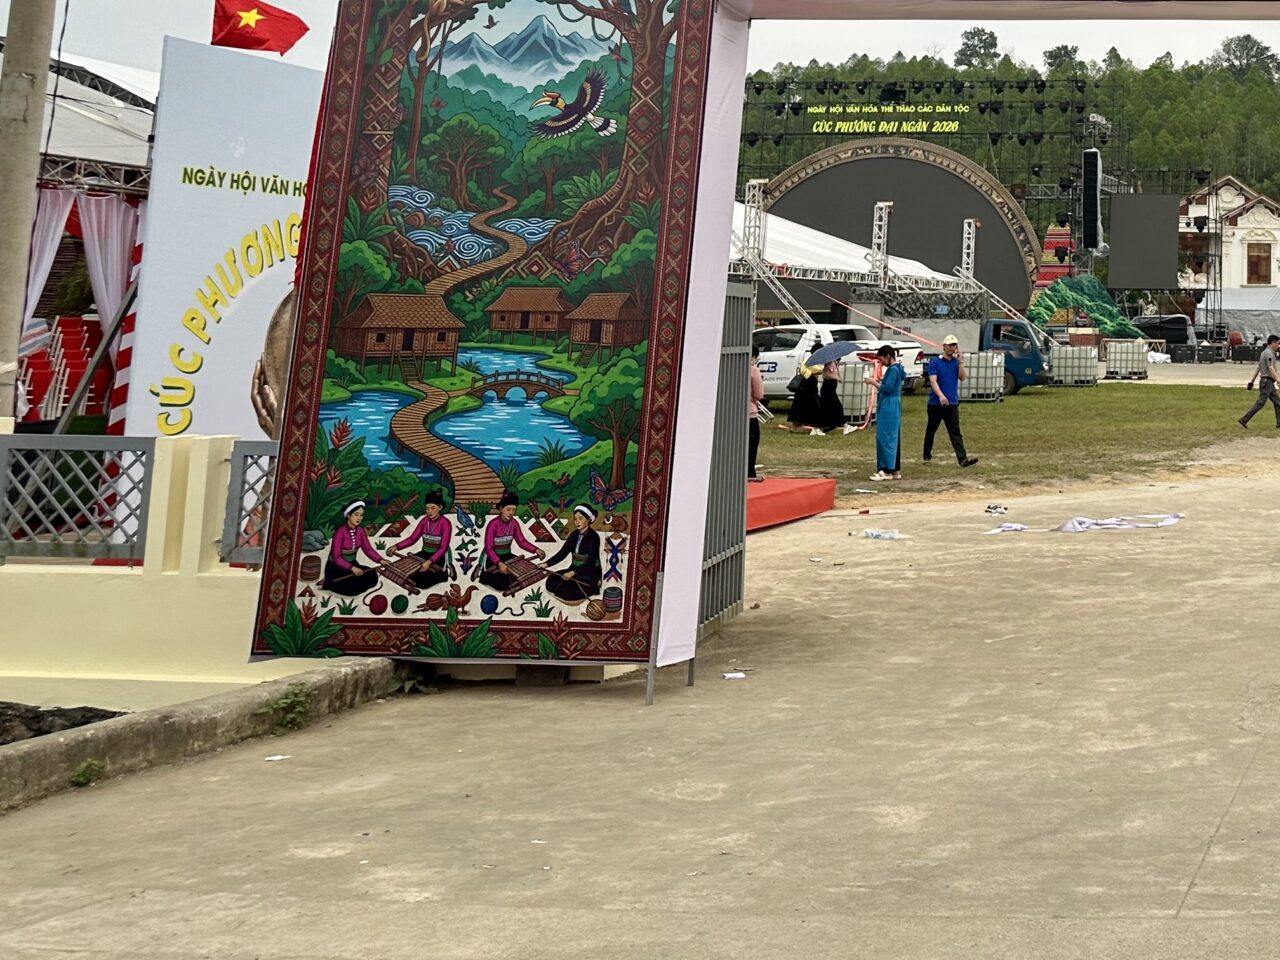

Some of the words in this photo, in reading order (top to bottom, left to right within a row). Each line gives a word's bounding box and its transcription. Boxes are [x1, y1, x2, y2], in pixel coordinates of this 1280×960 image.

[807, 104, 827, 113] NGÀY
[829, 104, 843, 115] HỘI
[862, 103, 878, 113] HÓA
[896, 104, 916, 113] THAO
[917, 103, 934, 113] CÁC
[954, 103, 970, 115] TỘC
[812, 120, 833, 133] CÚC
[835, 120, 876, 133] PHƯƠNG
[878, 121, 899, 135] ĐẠI
[900, 119, 930, 133] NGÀN
[932, 121, 960, 133] 2026
[182, 166, 226, 189] NGÀY
[229, 171, 257, 196] HỘI
[260, 176, 290, 197] VĂN
[149, 342, 204, 436] CÚC
[181, 212, 302, 345] PHƯƠNG
